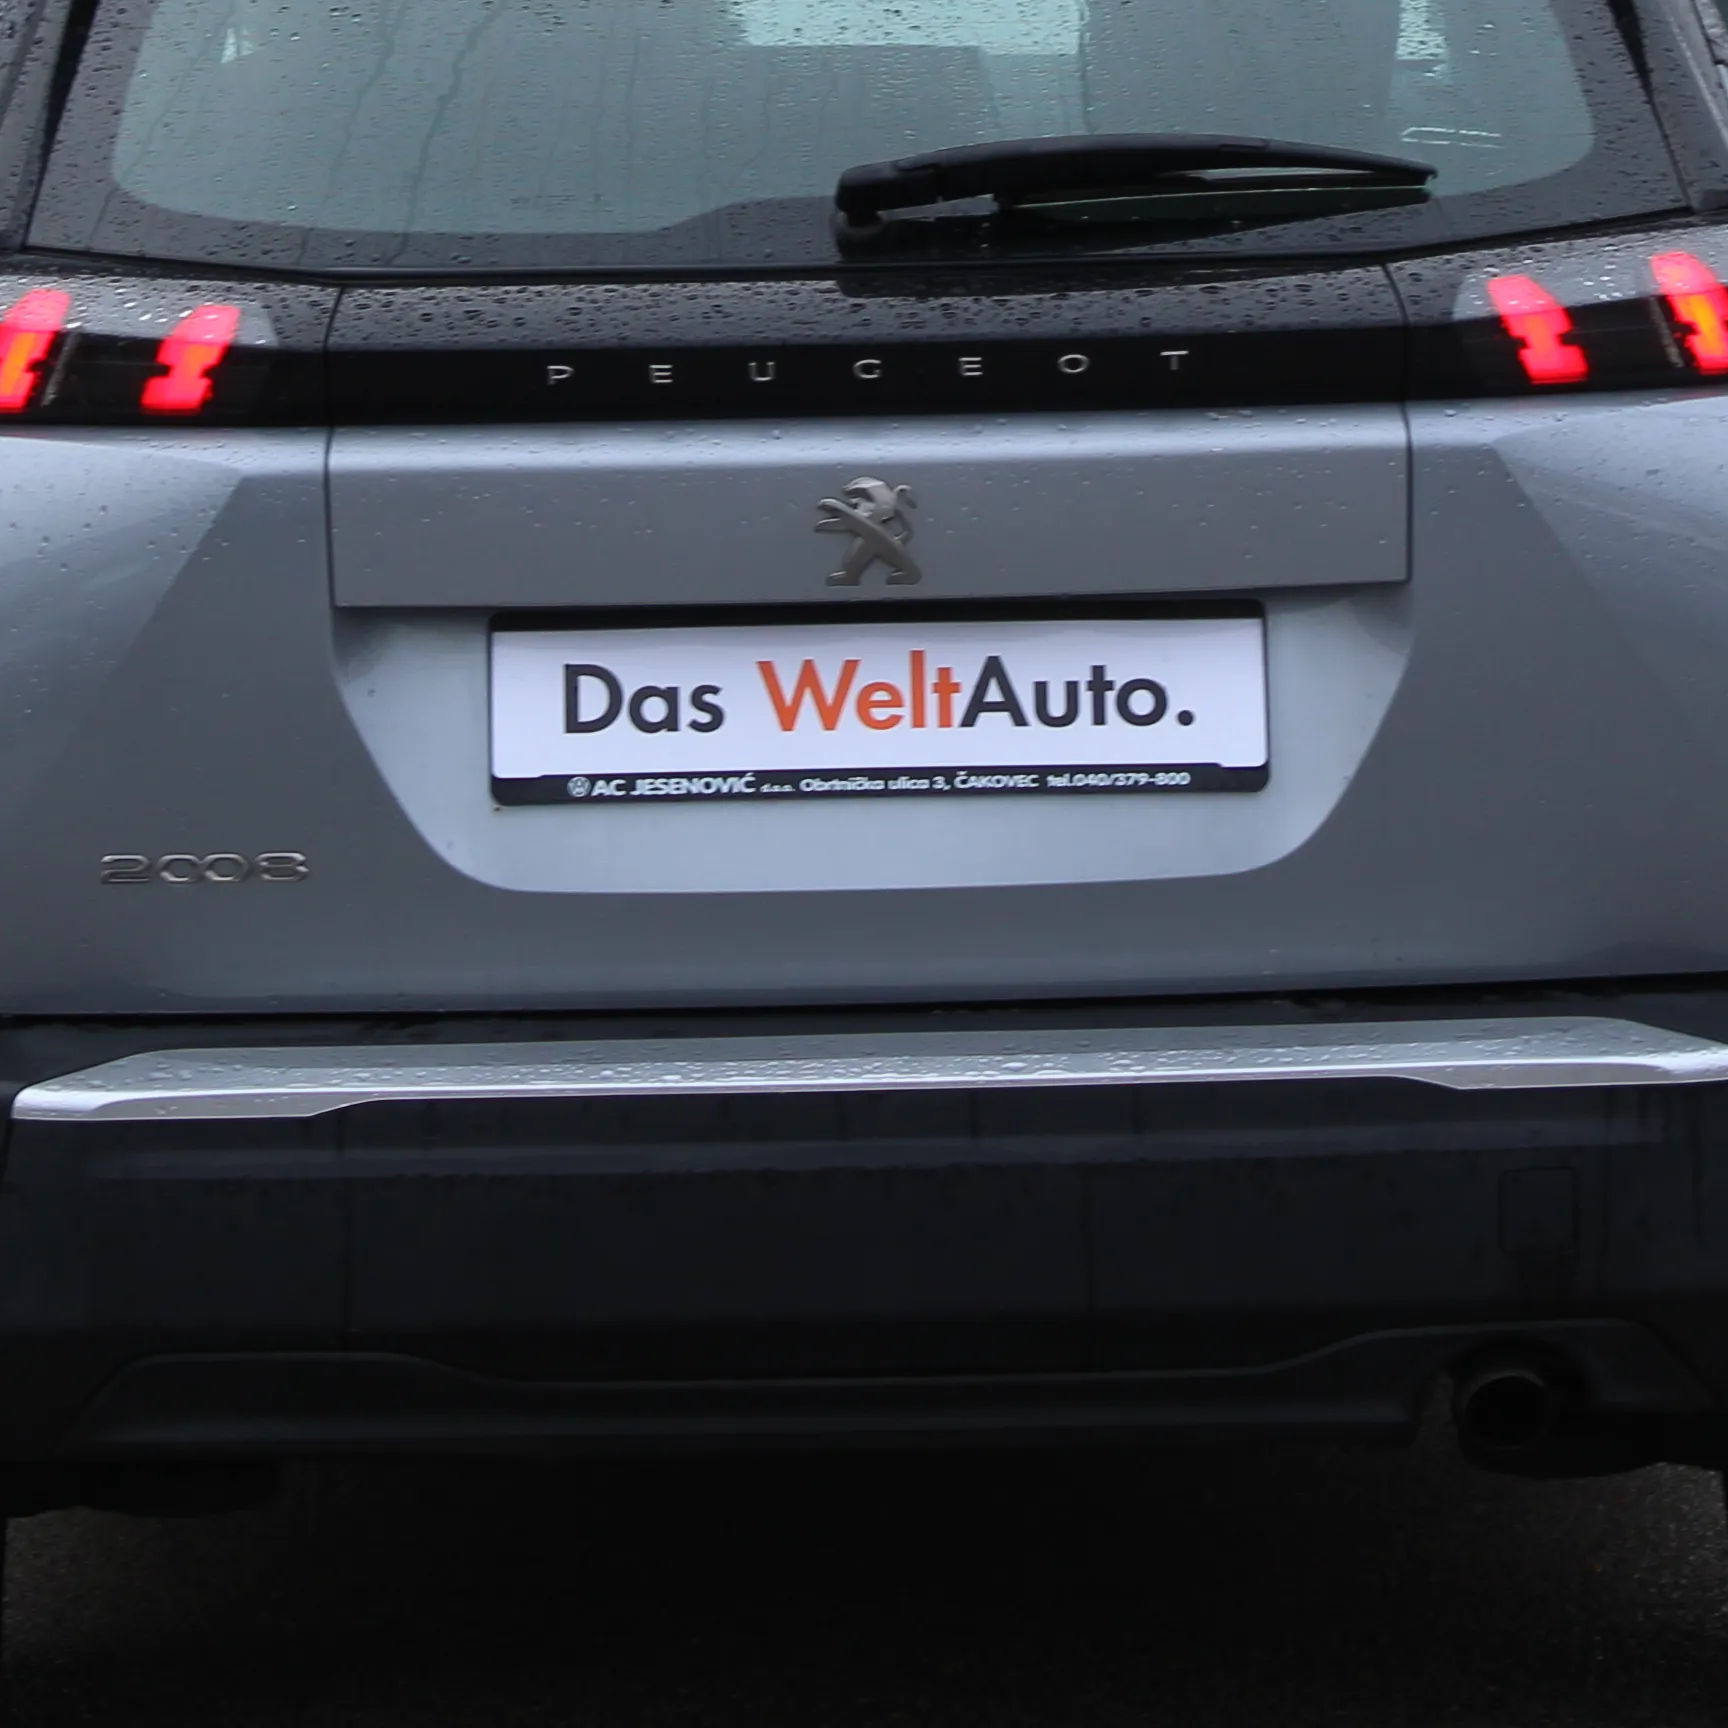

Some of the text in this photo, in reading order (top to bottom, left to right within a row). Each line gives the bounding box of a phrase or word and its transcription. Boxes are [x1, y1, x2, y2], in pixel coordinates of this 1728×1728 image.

[545, 349, 1190, 385] PEUGEOT
[562, 648, 1195, 735] Das WeltAuto.
[590, 779, 627, 797] AC
[629, 772, 757, 796] JESENOVIĆ
[887, 776, 931, 791] ulica
[931, 775, 952, 791] 3,
[953, 770, 1040, 789] ČAKOVEC
[100, 851, 311, 885] 2008
